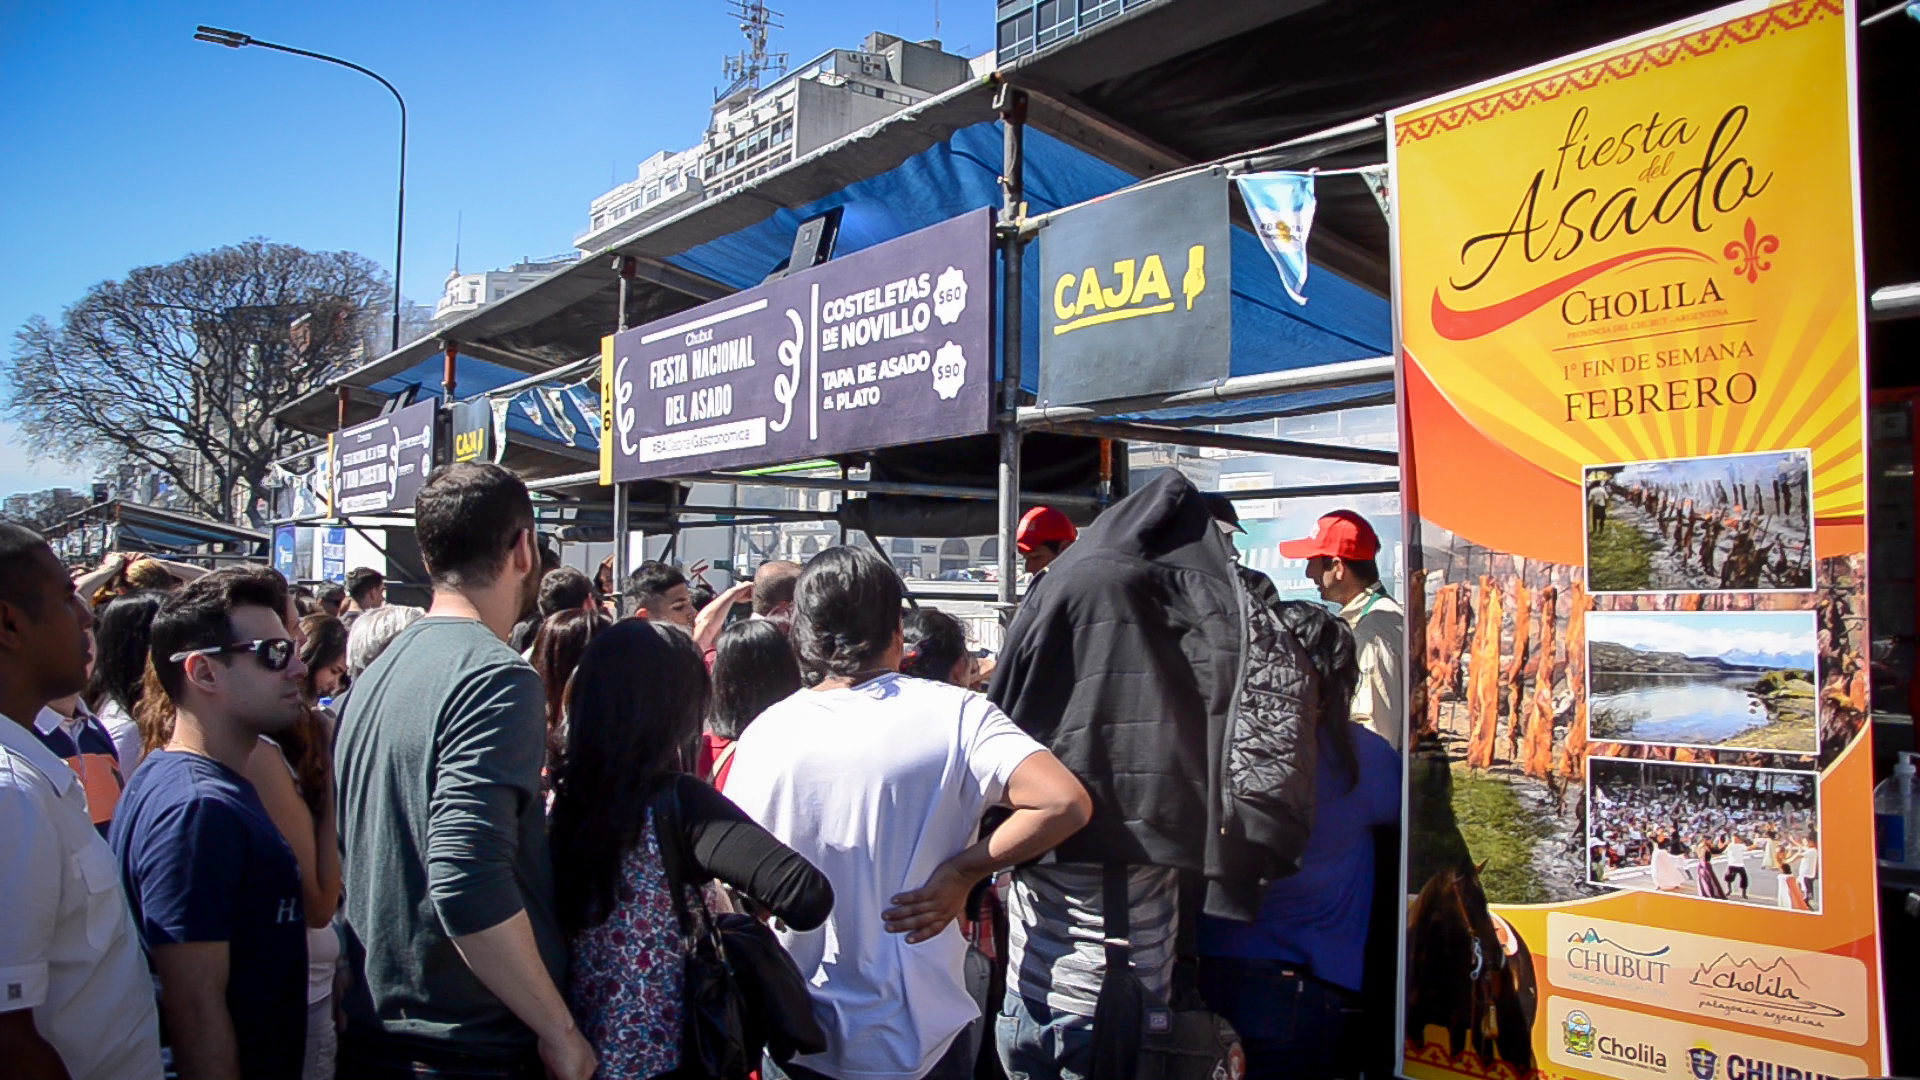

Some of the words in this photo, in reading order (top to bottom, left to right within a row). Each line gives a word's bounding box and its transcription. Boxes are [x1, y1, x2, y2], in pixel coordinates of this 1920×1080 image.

[1551, 105, 1700, 191] fiesta
[1638, 150, 1672, 184] del
[1449, 104, 1774, 291] Asado
[822, 272, 931, 324] COSTELETAS
[938, 286, 962, 305] $60
[1053, 254, 1172, 321] CAJA
[1561, 276, 1725, 328] CHOLILA
[822, 326, 839, 347] DE
[841, 302, 931, 350] NOVILLO
[649, 353, 689, 390] FIESTA
[692, 335, 756, 380] NACIONAL
[822, 367, 856, 391] TAPA
[857, 361, 877, 385] DE
[878, 350, 931, 380] ASADO
[937, 362, 960, 381] $90
[1582, 358, 1616, 378] FIN
[1620, 353, 1651, 374] DE
[1656, 340, 1754, 369] SEMANA
[665, 394, 688, 426] DEL
[690, 383, 733, 421] ASADO
[836, 386, 881, 411] PLATO
[1564, 372, 1758, 423] FEBRERO
[1567, 947, 1671, 984] CHUBUT
[1713, 971, 1800, 1000] Cholila
[1598, 1036, 1667, 1068] Cholila
[1727, 1054, 1840, 1080] CHU
